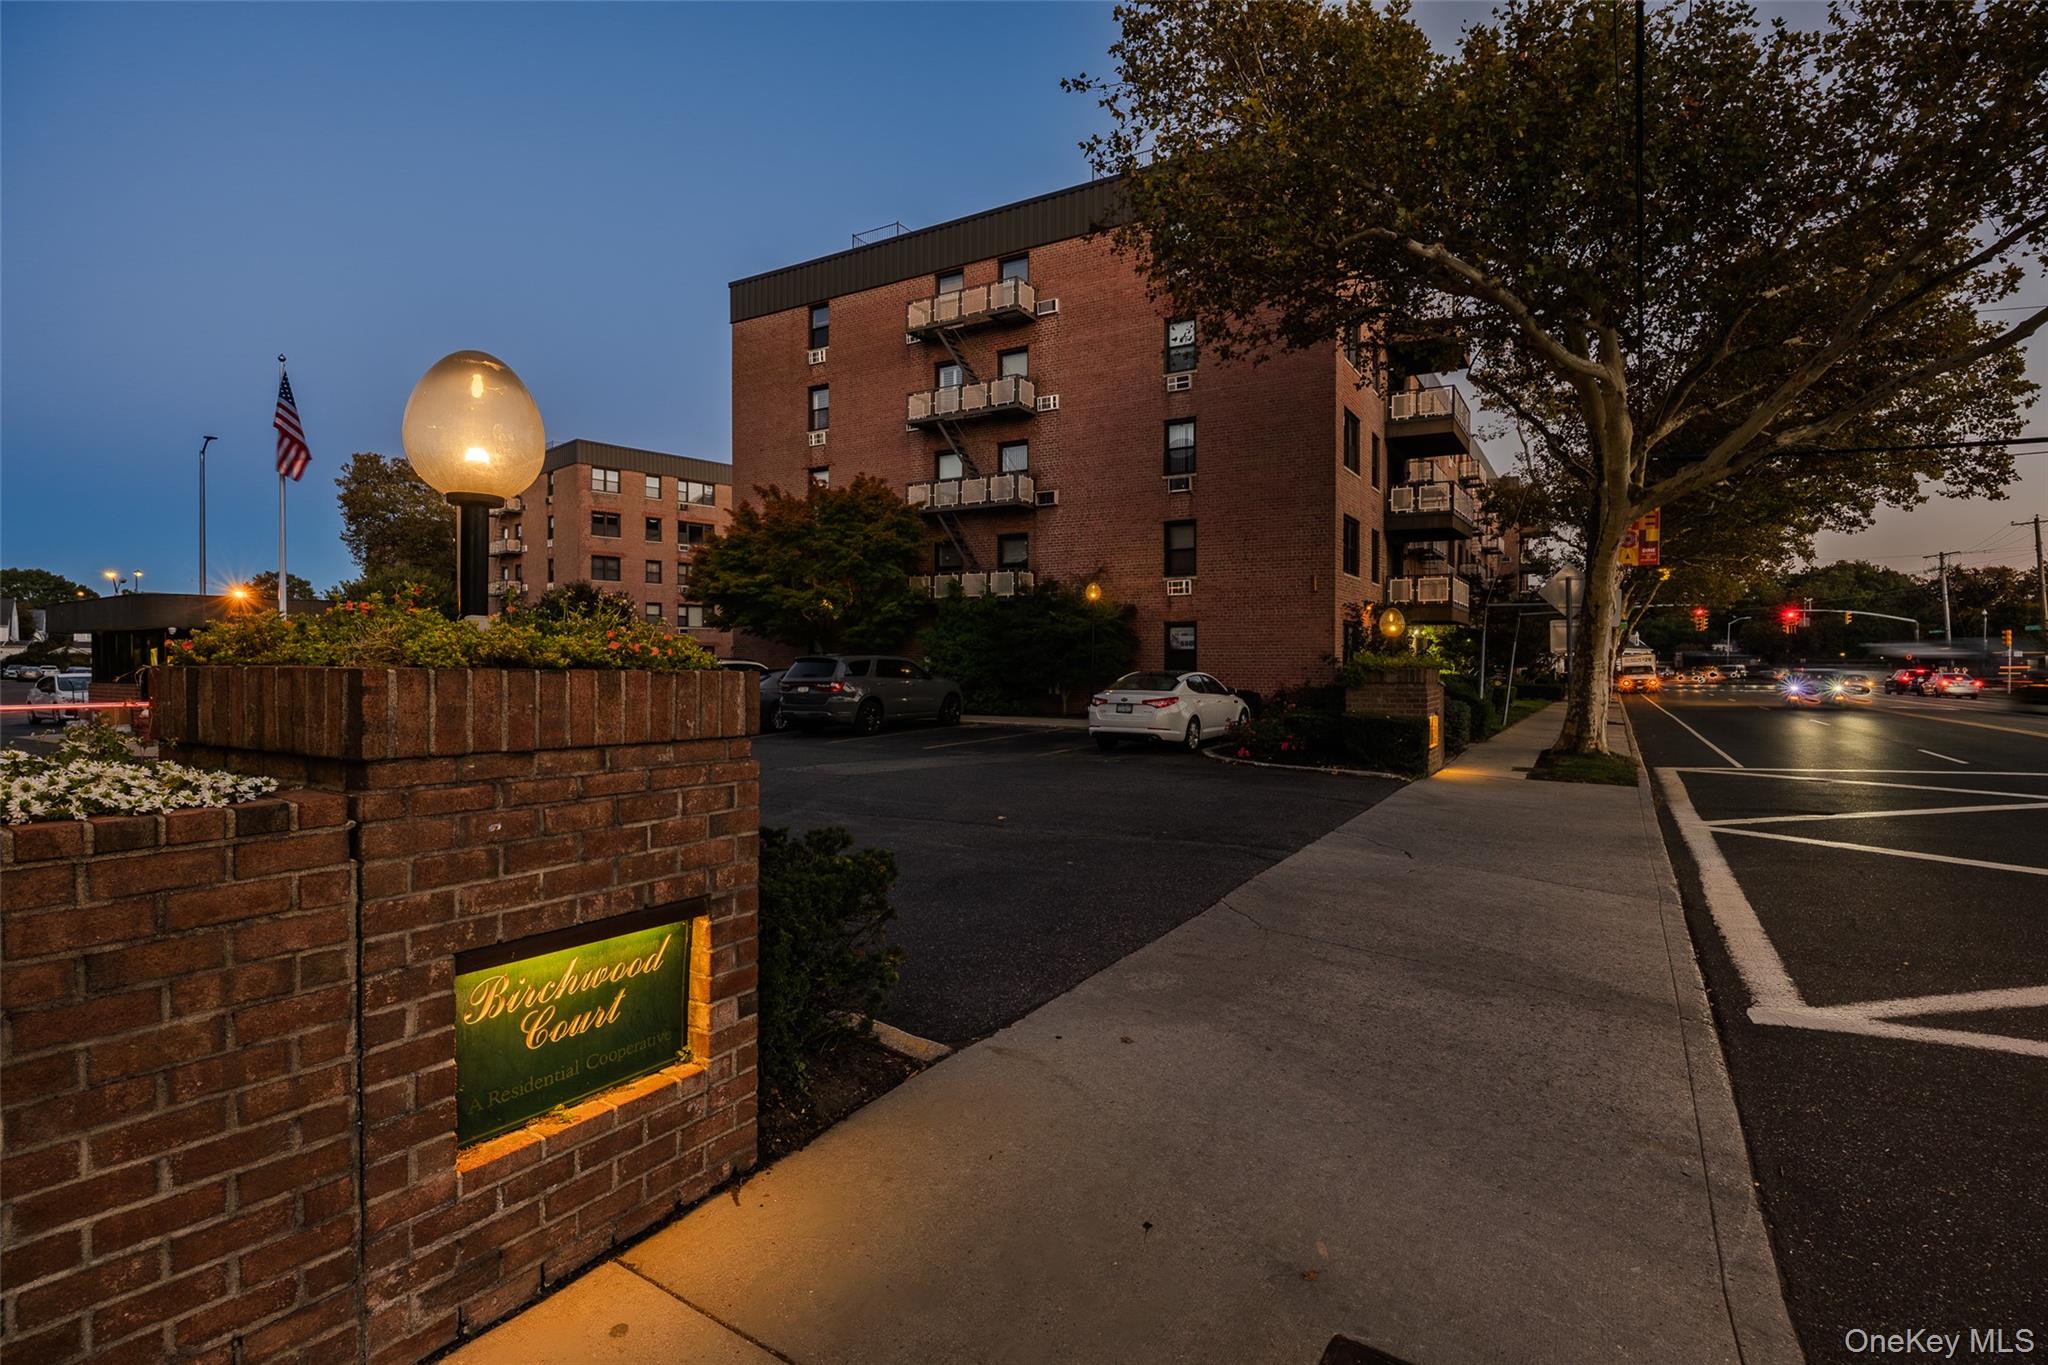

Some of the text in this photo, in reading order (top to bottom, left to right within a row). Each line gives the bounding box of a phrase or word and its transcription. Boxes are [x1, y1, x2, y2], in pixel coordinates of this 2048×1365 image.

[463, 933, 672, 1025] Birchwood
[520, 987, 626, 1050] Court
[467, 1030, 672, 1114] A Residential Cooperative
